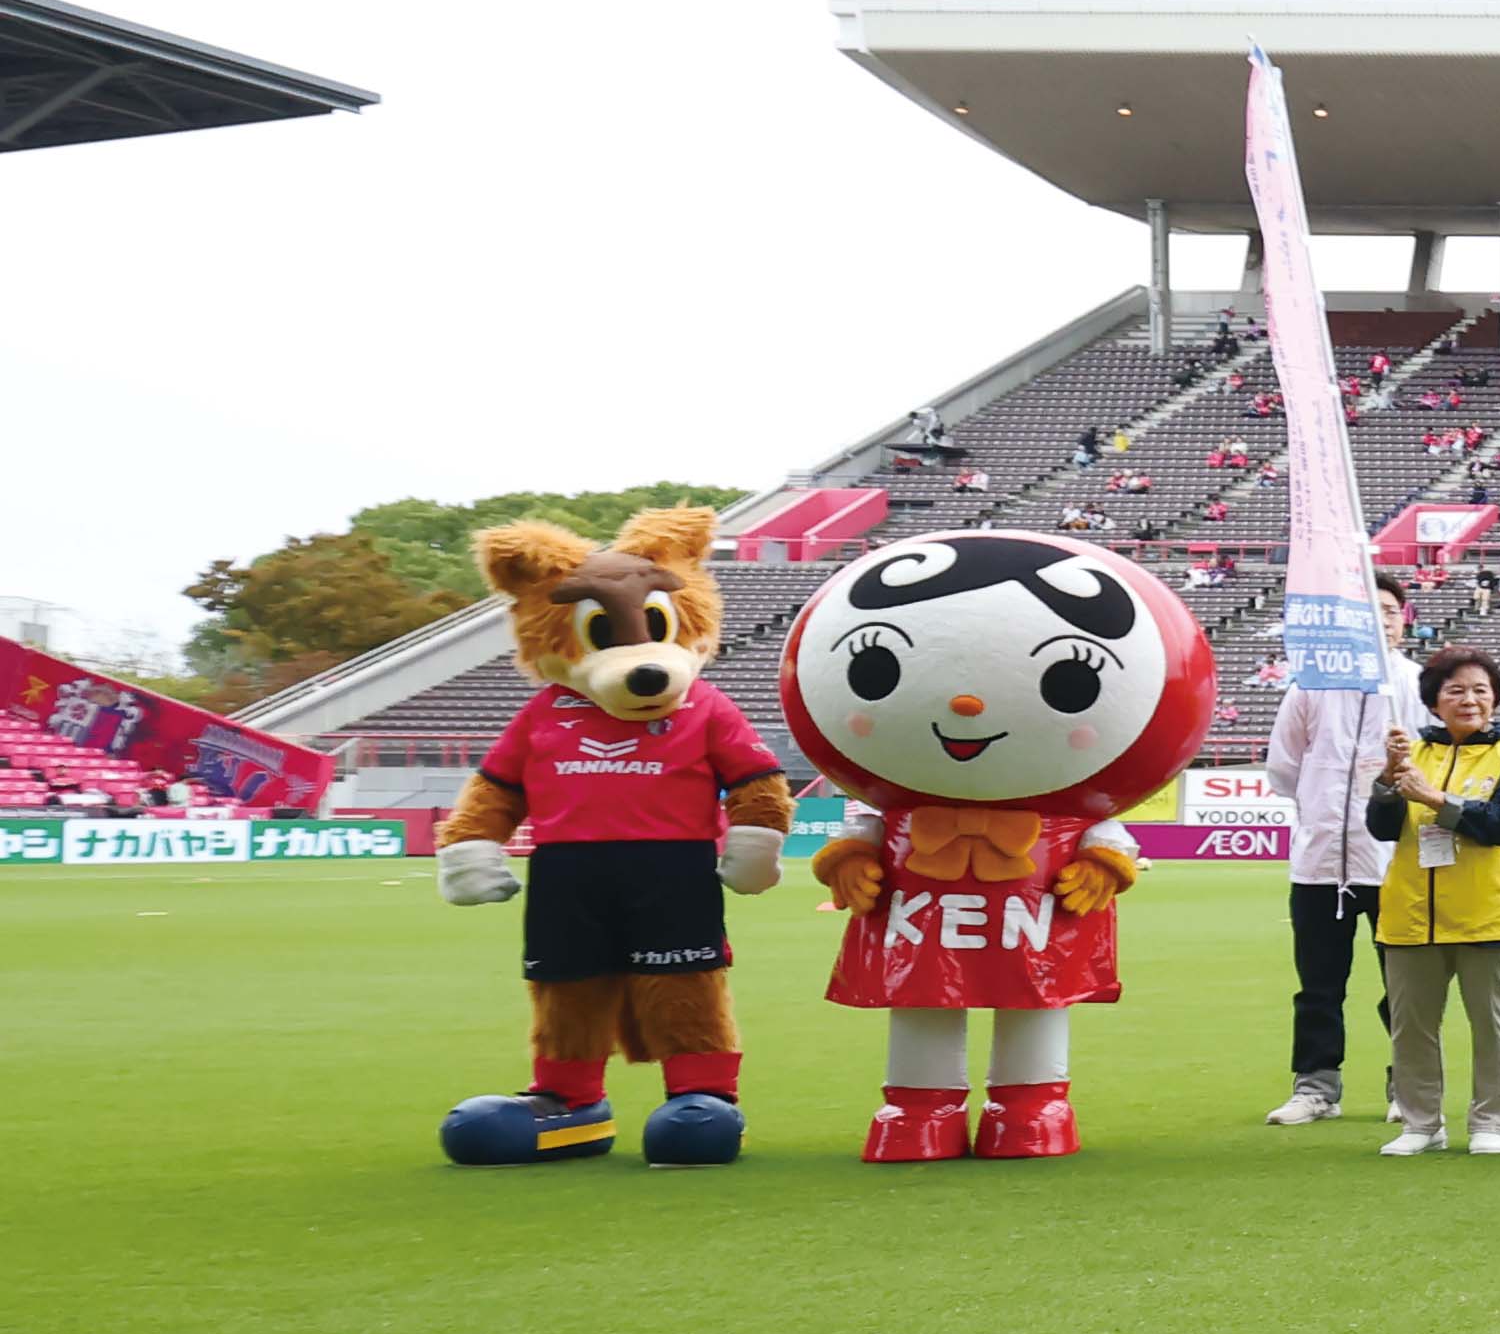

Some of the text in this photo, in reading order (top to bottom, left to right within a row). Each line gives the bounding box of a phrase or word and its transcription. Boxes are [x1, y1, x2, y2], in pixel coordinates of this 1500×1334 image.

[553, 760, 664, 776] YANMAR
[1195, 811, 1287, 825] YODOKO
[76, 829, 241, 857] ナカバヤシ
[252, 826, 399, 858] ナカバヤシ
[883, 890, 1056, 955] KEN
